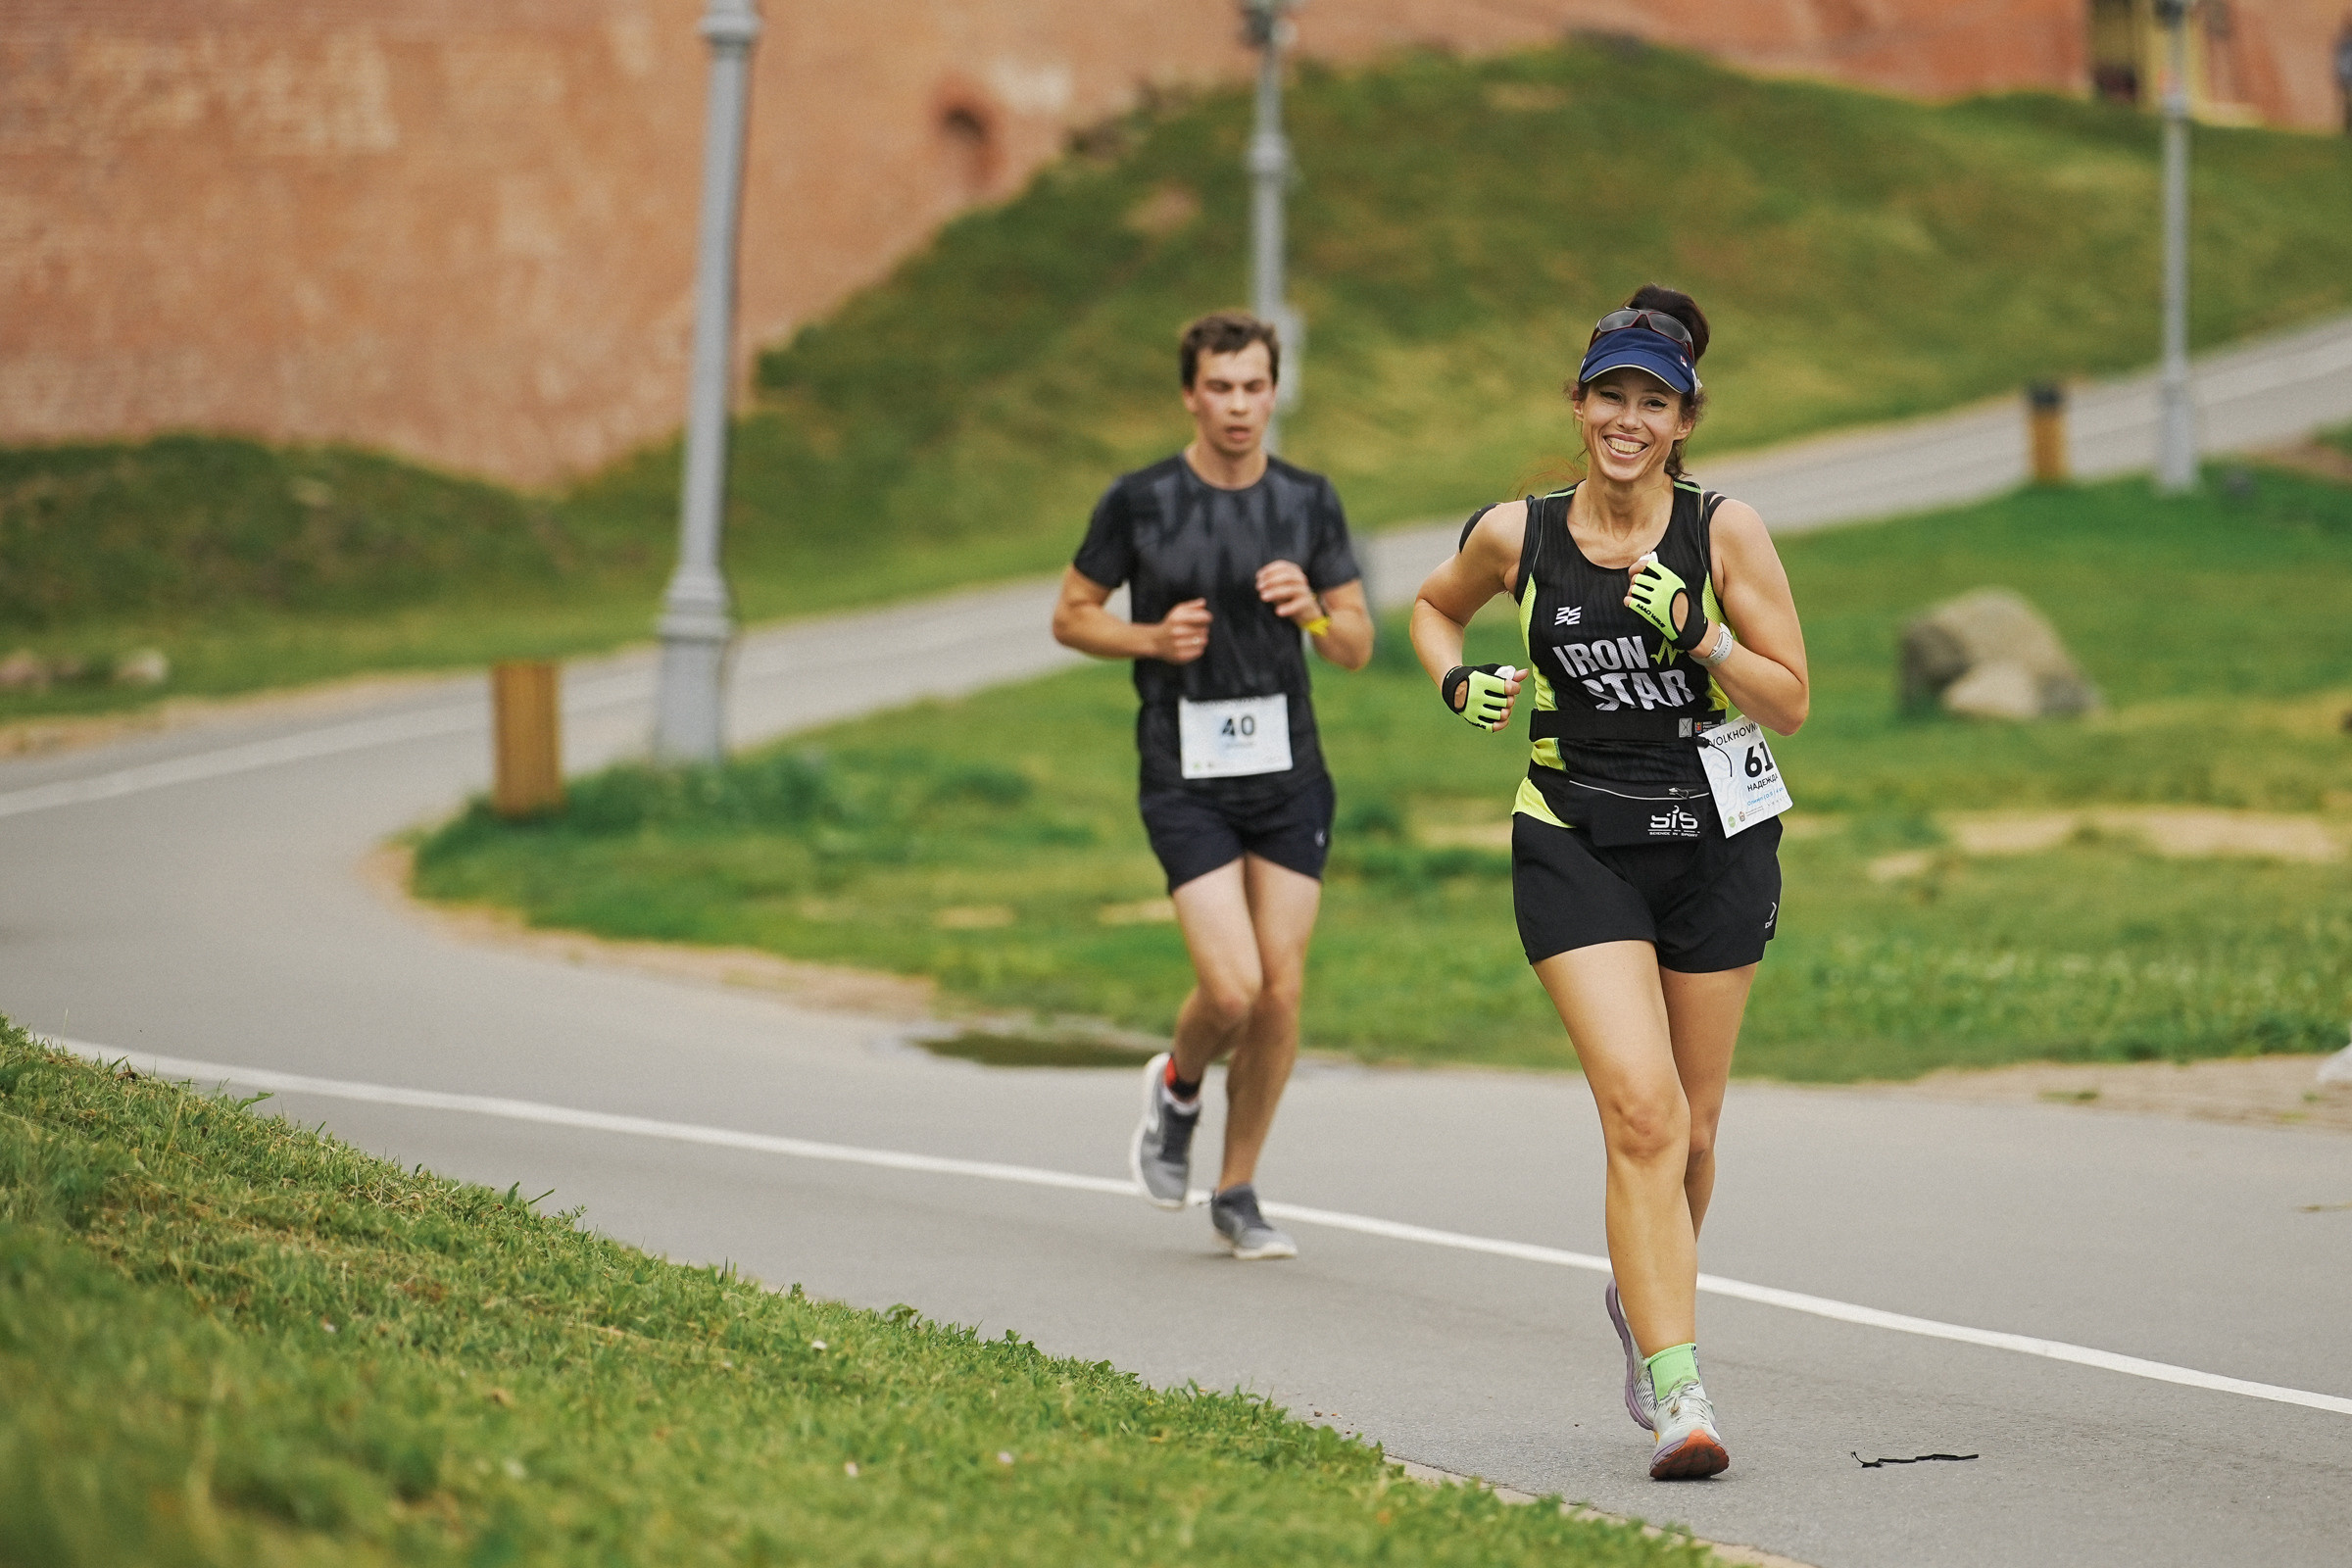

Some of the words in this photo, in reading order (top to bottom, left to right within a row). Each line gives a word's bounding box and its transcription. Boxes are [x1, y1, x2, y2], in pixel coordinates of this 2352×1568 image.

[1636, 604, 1652, 615] MAD
[1552, 635, 1649, 678] IRON
[1582, 669, 1695, 711] STAR
[1222, 715, 1255, 737] 40
[1744, 740, 1774, 778] 61
